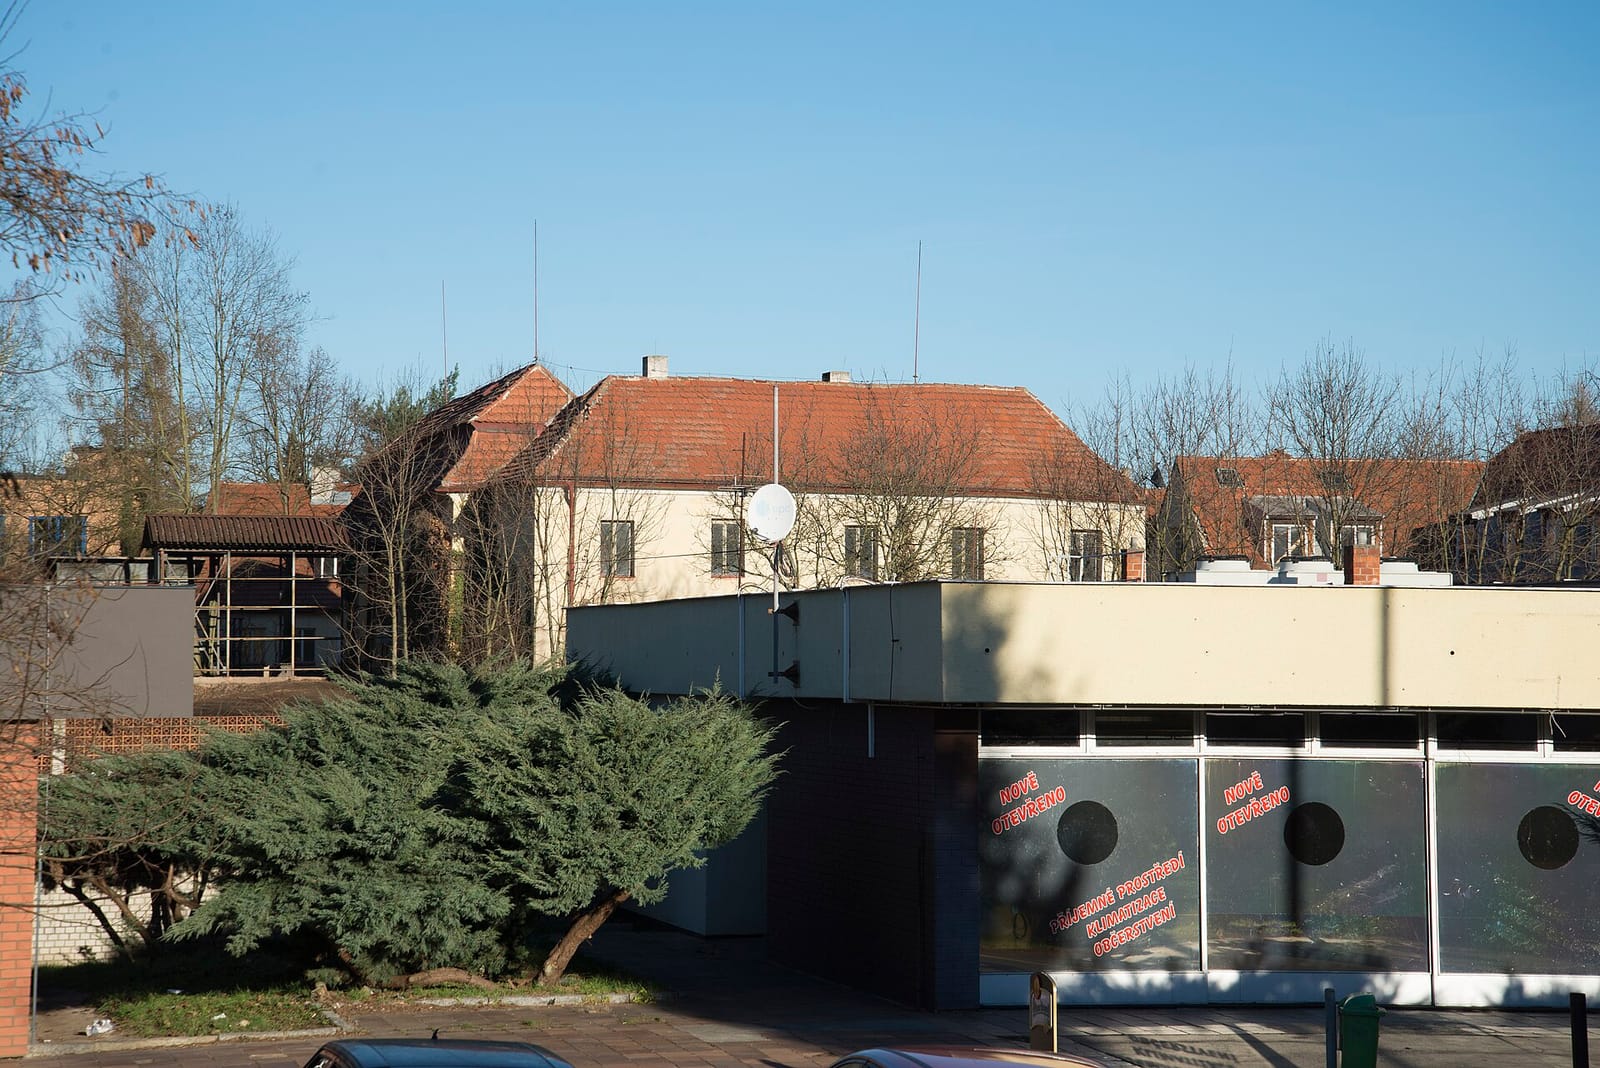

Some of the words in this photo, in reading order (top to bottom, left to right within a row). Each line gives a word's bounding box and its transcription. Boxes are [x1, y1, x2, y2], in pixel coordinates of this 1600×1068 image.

[992, 786, 1066, 835] OTEVŘENO
[1000, 771, 1039, 805] NOVĚ
[1217, 786, 1290, 834] OTEVŘENO
[1224, 770, 1263, 805] NOVĚ
[1049, 887, 1116, 934] PŘÍJEMNÉ
[1116, 849, 1186, 899] PROSTŘEDÍ
[1086, 887, 1166, 939] KLIMATIZACE
[1094, 900, 1176, 956] OBČERSTVENÍ
